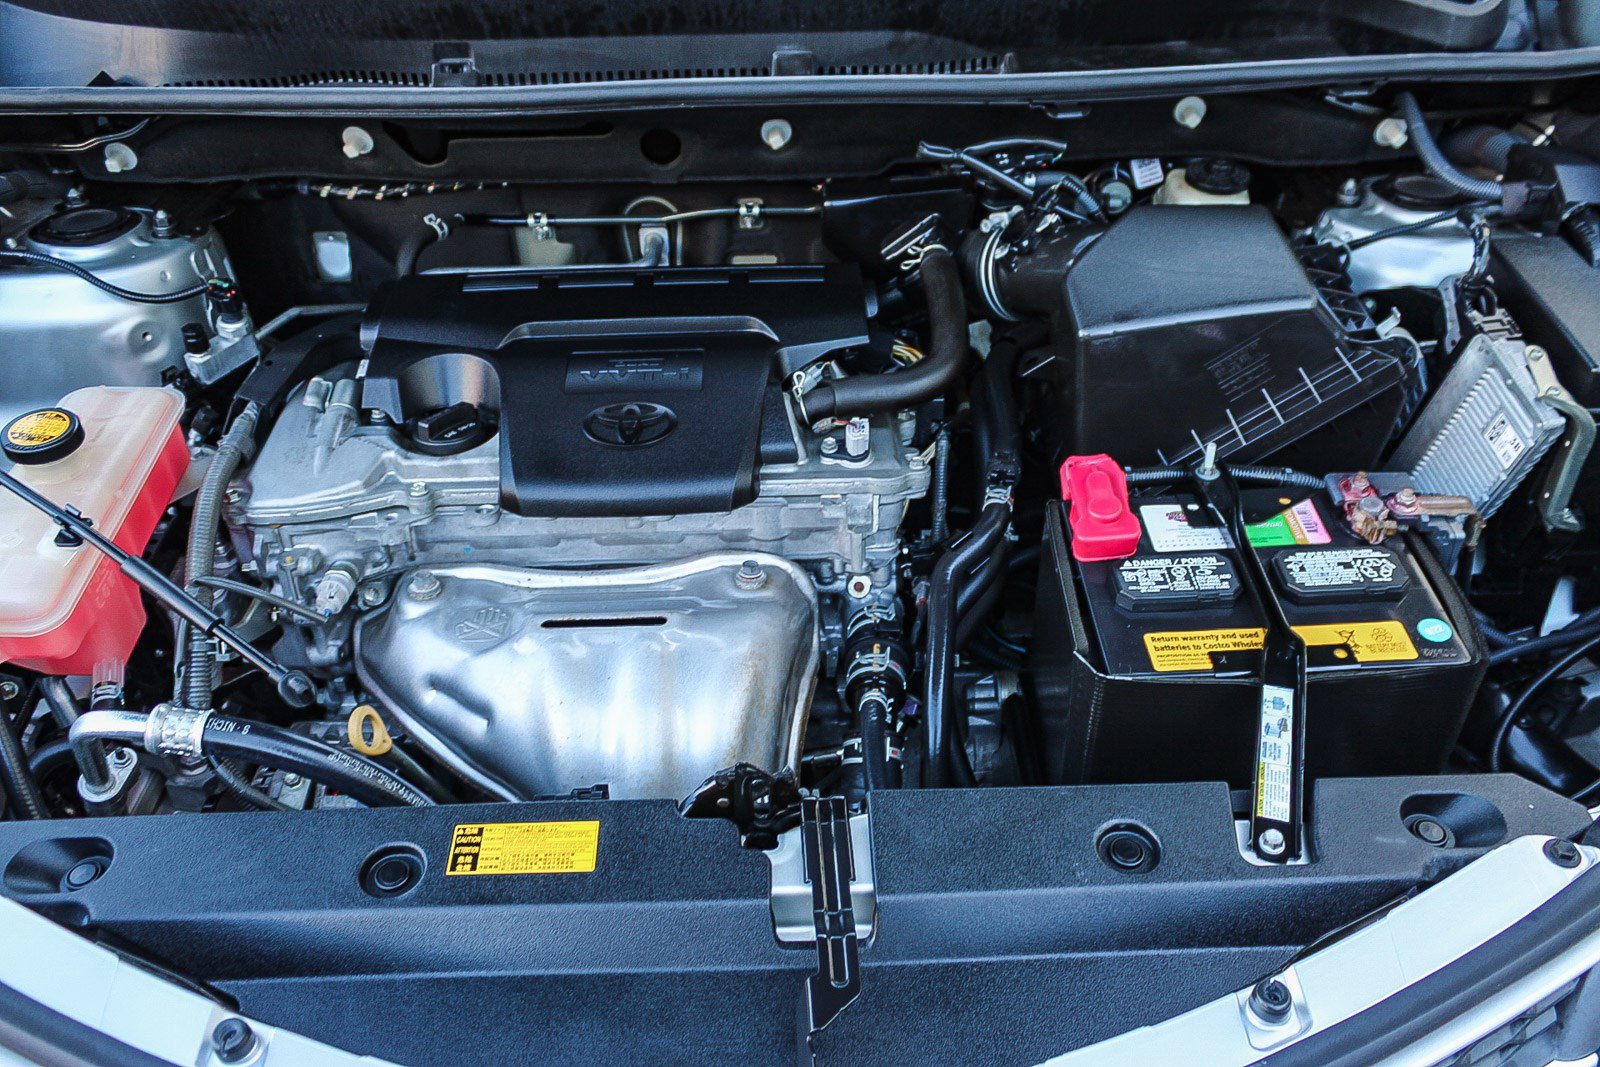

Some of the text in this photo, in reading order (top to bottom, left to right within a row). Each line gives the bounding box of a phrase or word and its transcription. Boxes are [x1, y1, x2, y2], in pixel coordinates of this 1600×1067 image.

[1132, 558, 1172, 567] DANGER
[1181, 556, 1217, 565] POISON
[1181, 634, 1219, 642] warranty
[1238, 631, 1260, 639] used
[1153, 643, 1192, 652] batteries
[1203, 642, 1231, 650] Costco
[456, 835, 482, 844] CAUTION
